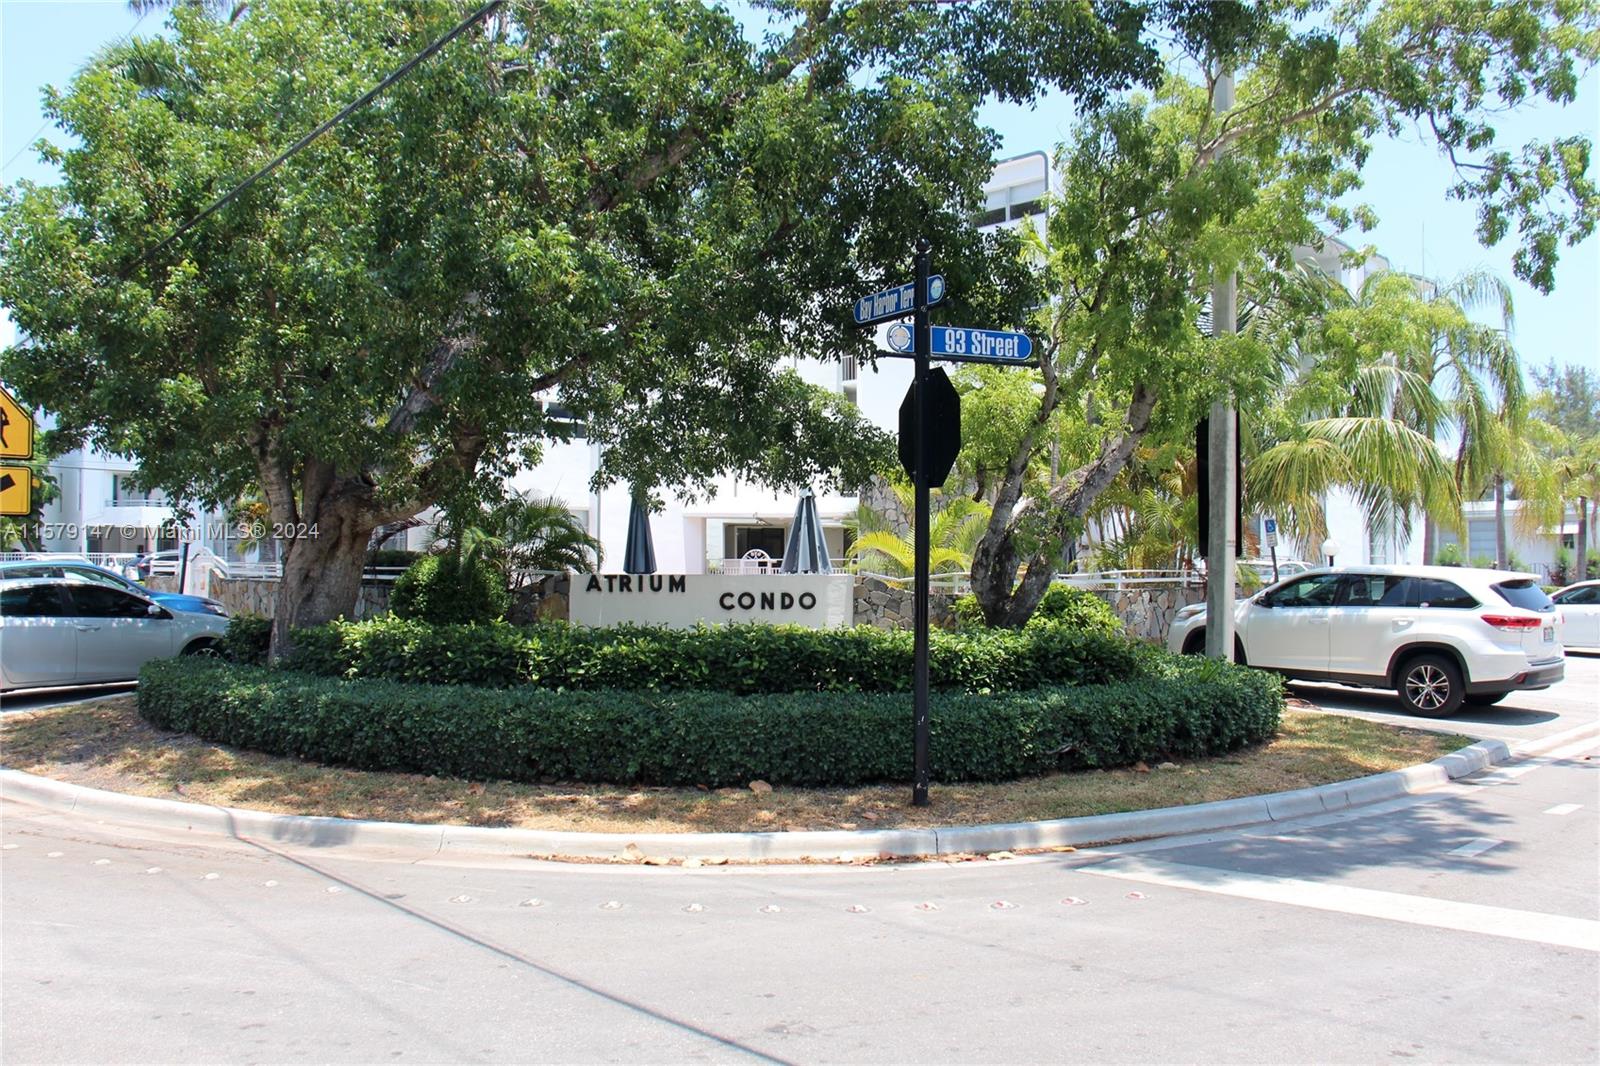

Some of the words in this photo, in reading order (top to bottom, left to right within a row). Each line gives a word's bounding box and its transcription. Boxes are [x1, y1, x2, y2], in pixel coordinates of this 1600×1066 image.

[860, 299, 873, 321] Bay
[874, 291, 898, 316] Harbor
[945, 330, 967, 354] 93
[971, 332, 1019, 357] Street
[586, 574, 686, 592] ATRIUM
[719, 592, 817, 610] CONDO
